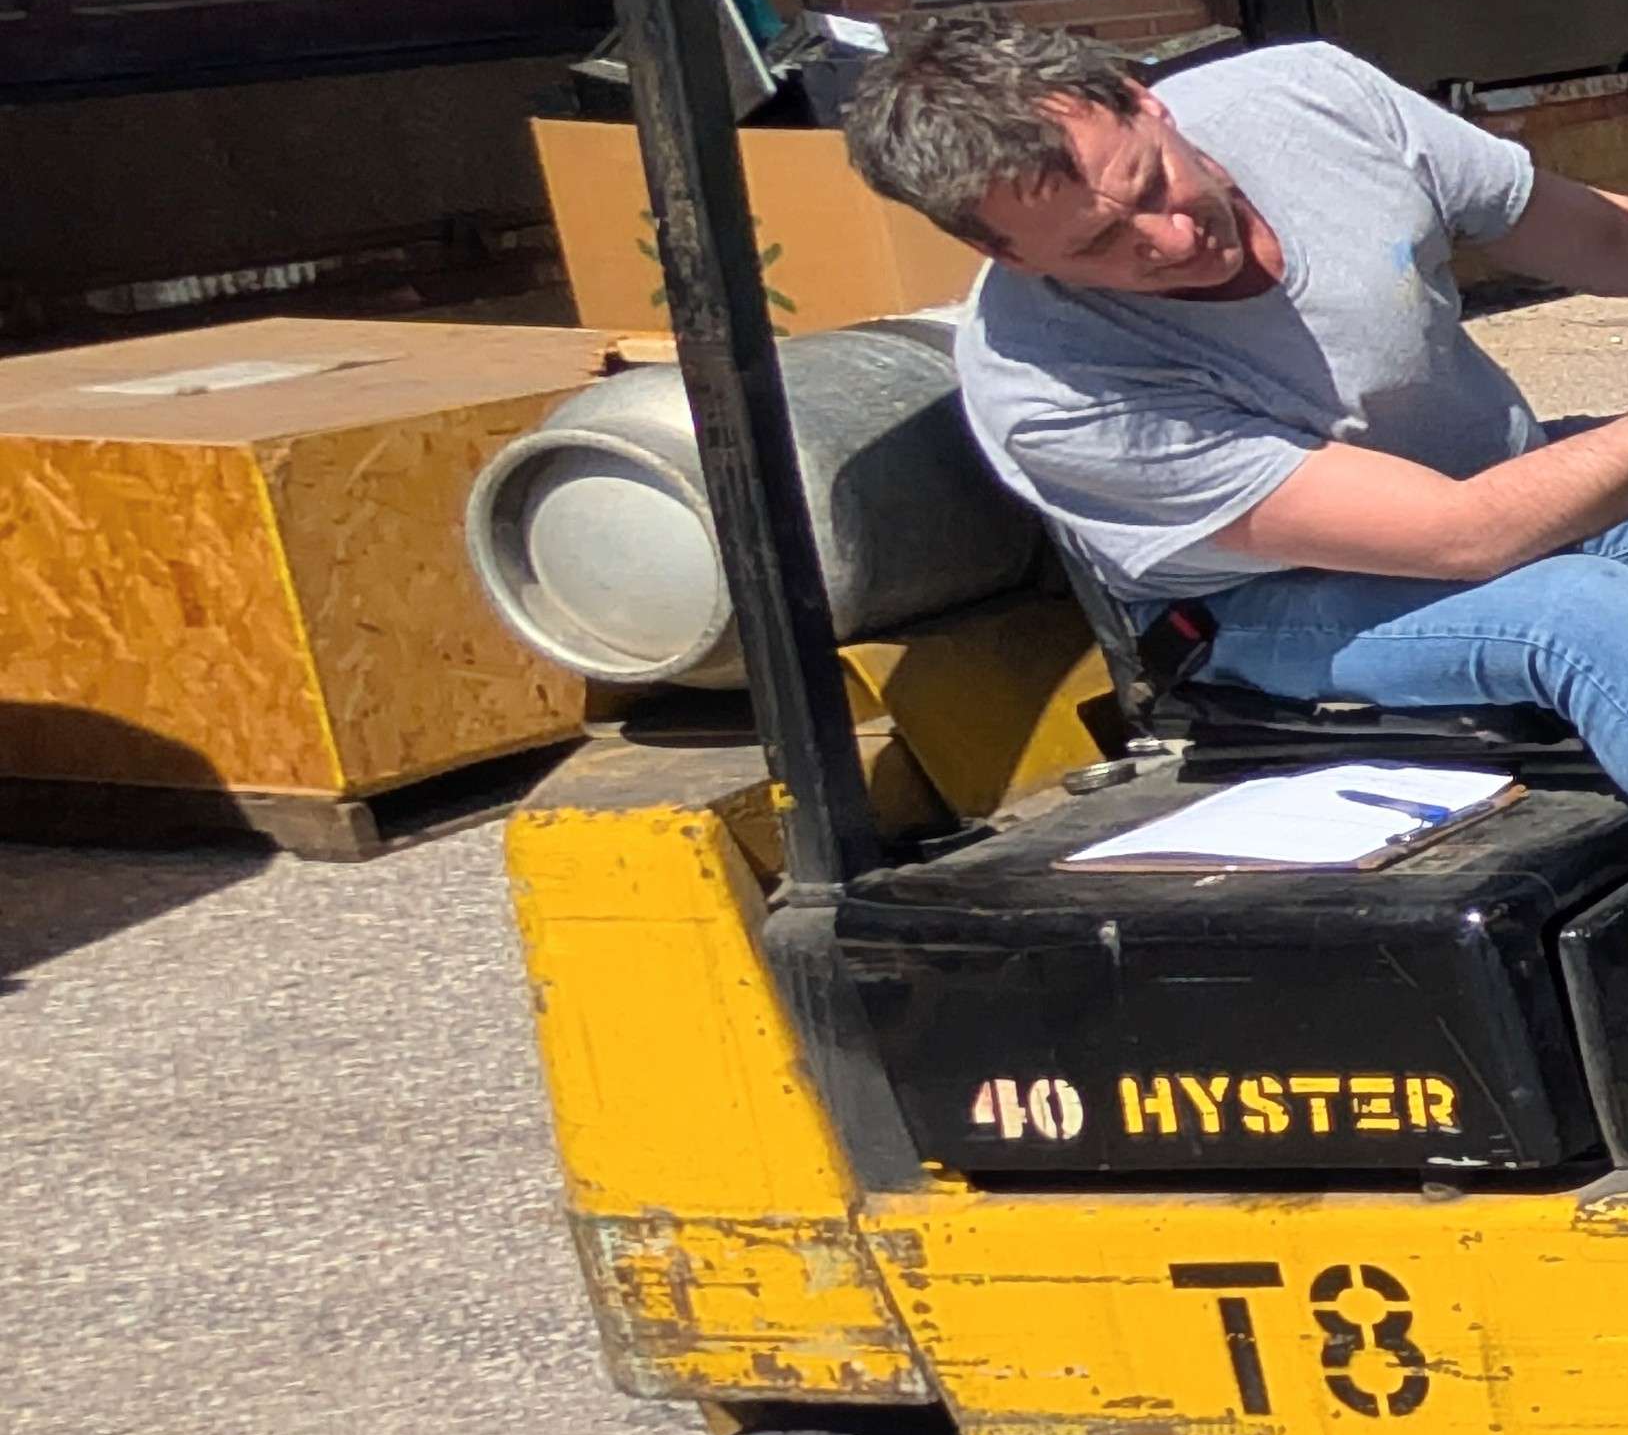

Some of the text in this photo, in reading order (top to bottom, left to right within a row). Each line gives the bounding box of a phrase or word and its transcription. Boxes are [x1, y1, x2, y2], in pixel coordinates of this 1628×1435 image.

[972, 1075, 1459, 1140] 40 HYSTER
[1168, 1262, 1430, 1418] T8
